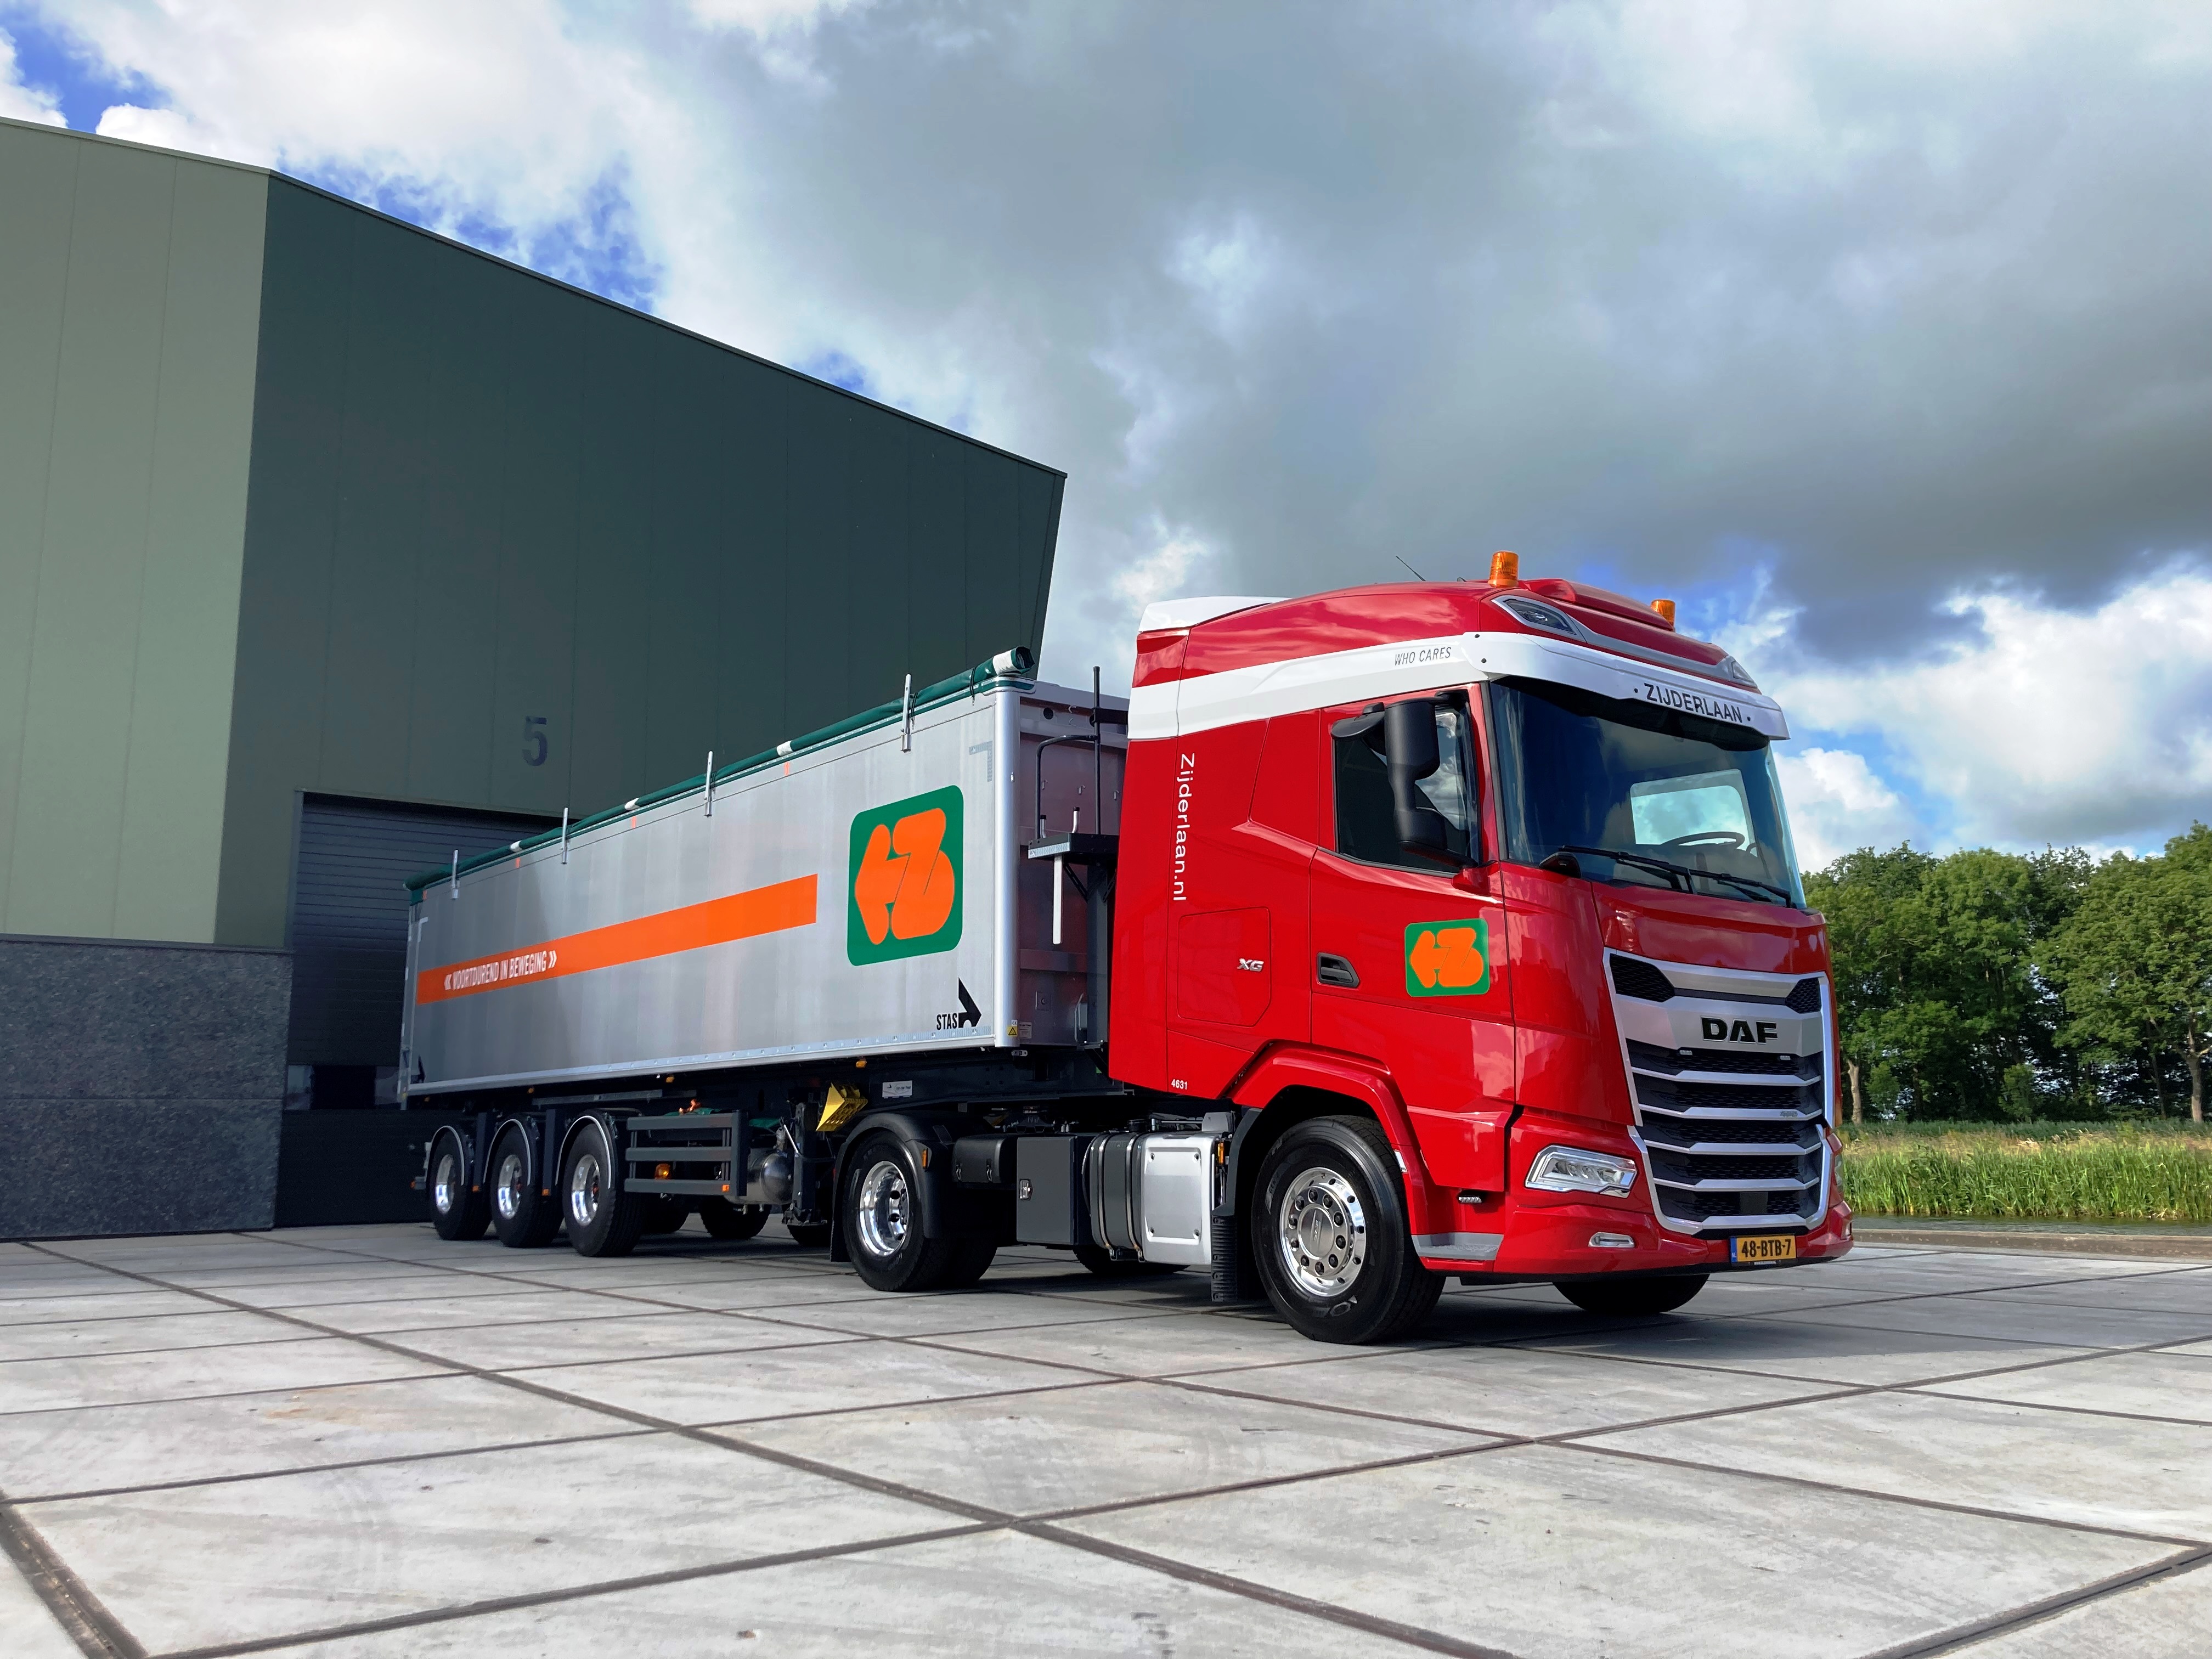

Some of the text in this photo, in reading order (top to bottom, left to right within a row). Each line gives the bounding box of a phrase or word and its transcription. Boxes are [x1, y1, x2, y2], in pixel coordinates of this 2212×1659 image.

[1395, 646, 1452, 666] WHO CARES
[1644, 682, 1743, 724] ZIJDERLAAN
[522, 716, 548, 766] 5
[1173, 753, 1195, 901] Zijderlaan.nl
[499, 959, 509, 980] IN
[509, 950, 547, 979] BEWEGING
[1237, 958, 1264, 972] XG
[936, 1012, 957, 1031] STAS
[1701, 1016, 1778, 1045] DAF
[1171, 1079, 1188, 1090] 4631
[1741, 1238, 1792, 1257] 48-BTB-7
